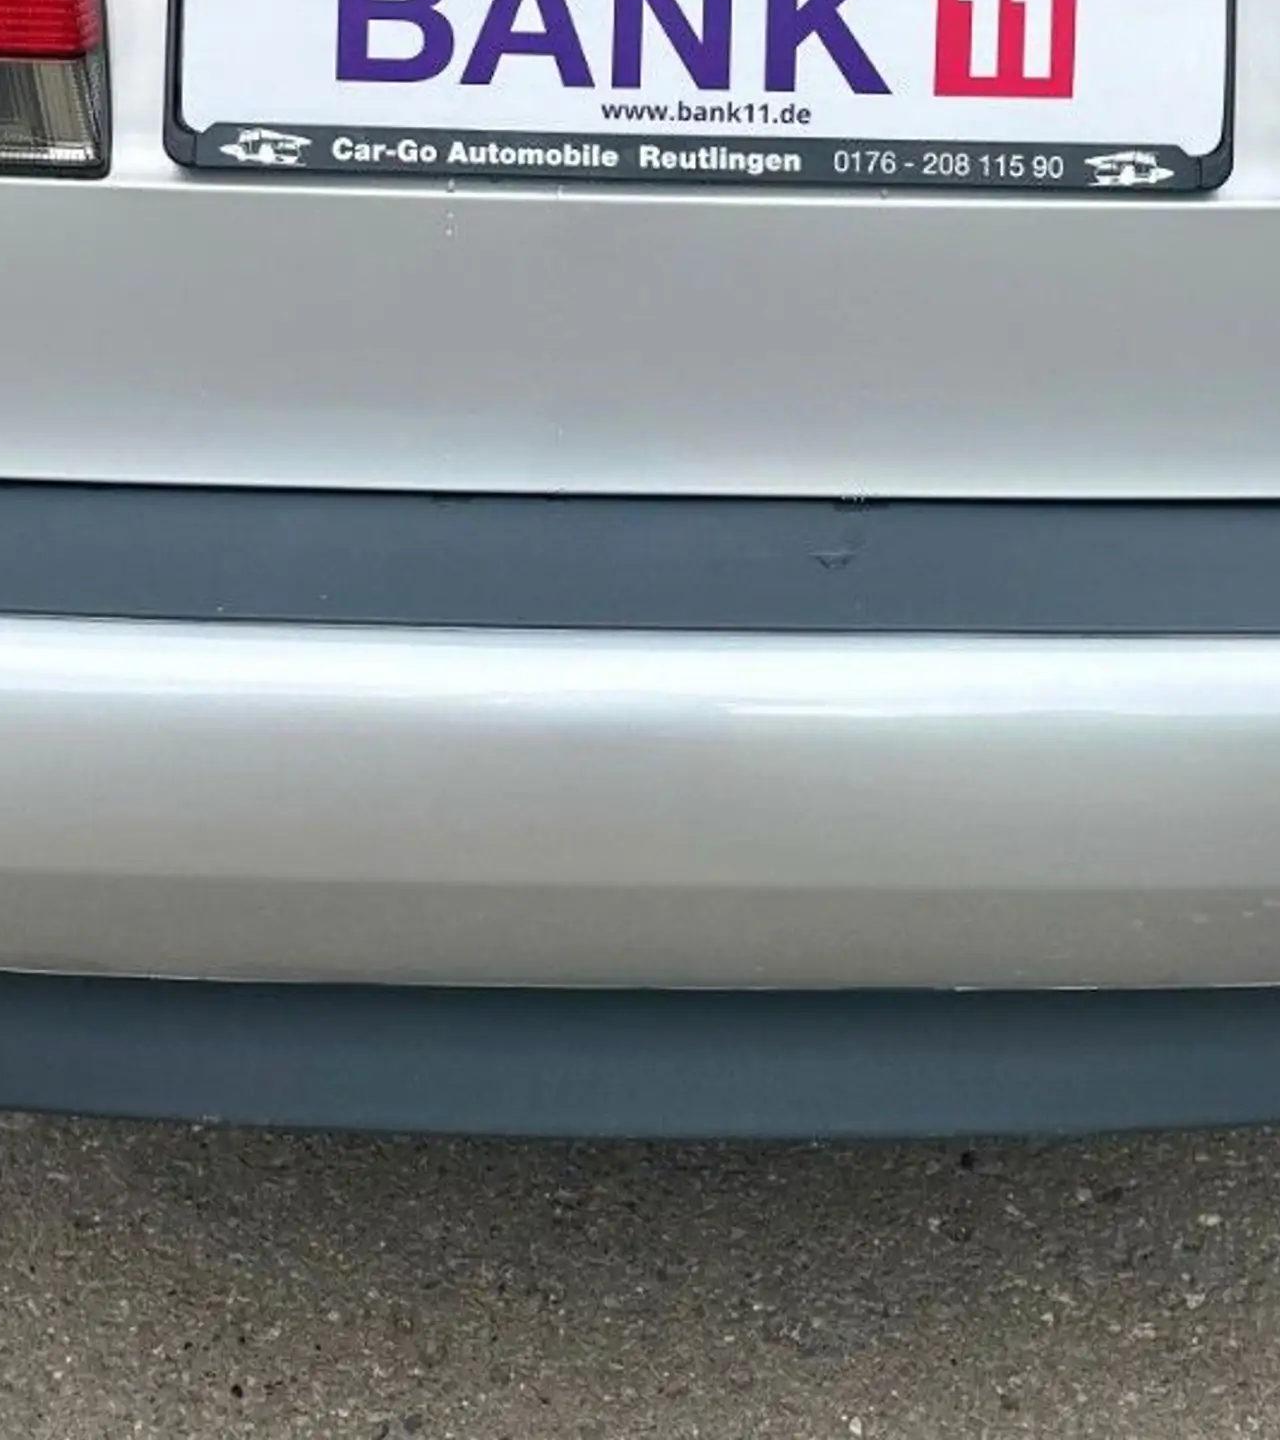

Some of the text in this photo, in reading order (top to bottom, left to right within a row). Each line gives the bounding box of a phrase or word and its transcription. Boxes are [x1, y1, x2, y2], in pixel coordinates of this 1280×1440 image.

[600, 100, 813, 125] www.bank11.de
[331, 136, 438, 165] Car-Go
[446, 139, 619, 168] Automobile
[638, 143, 803, 176] Reutlingen
[833, 149, 897, 175] 0176
[922, 152, 971, 177] 208
[977, 154, 1026, 179] 115
[1031, 155, 1065, 180] 90
